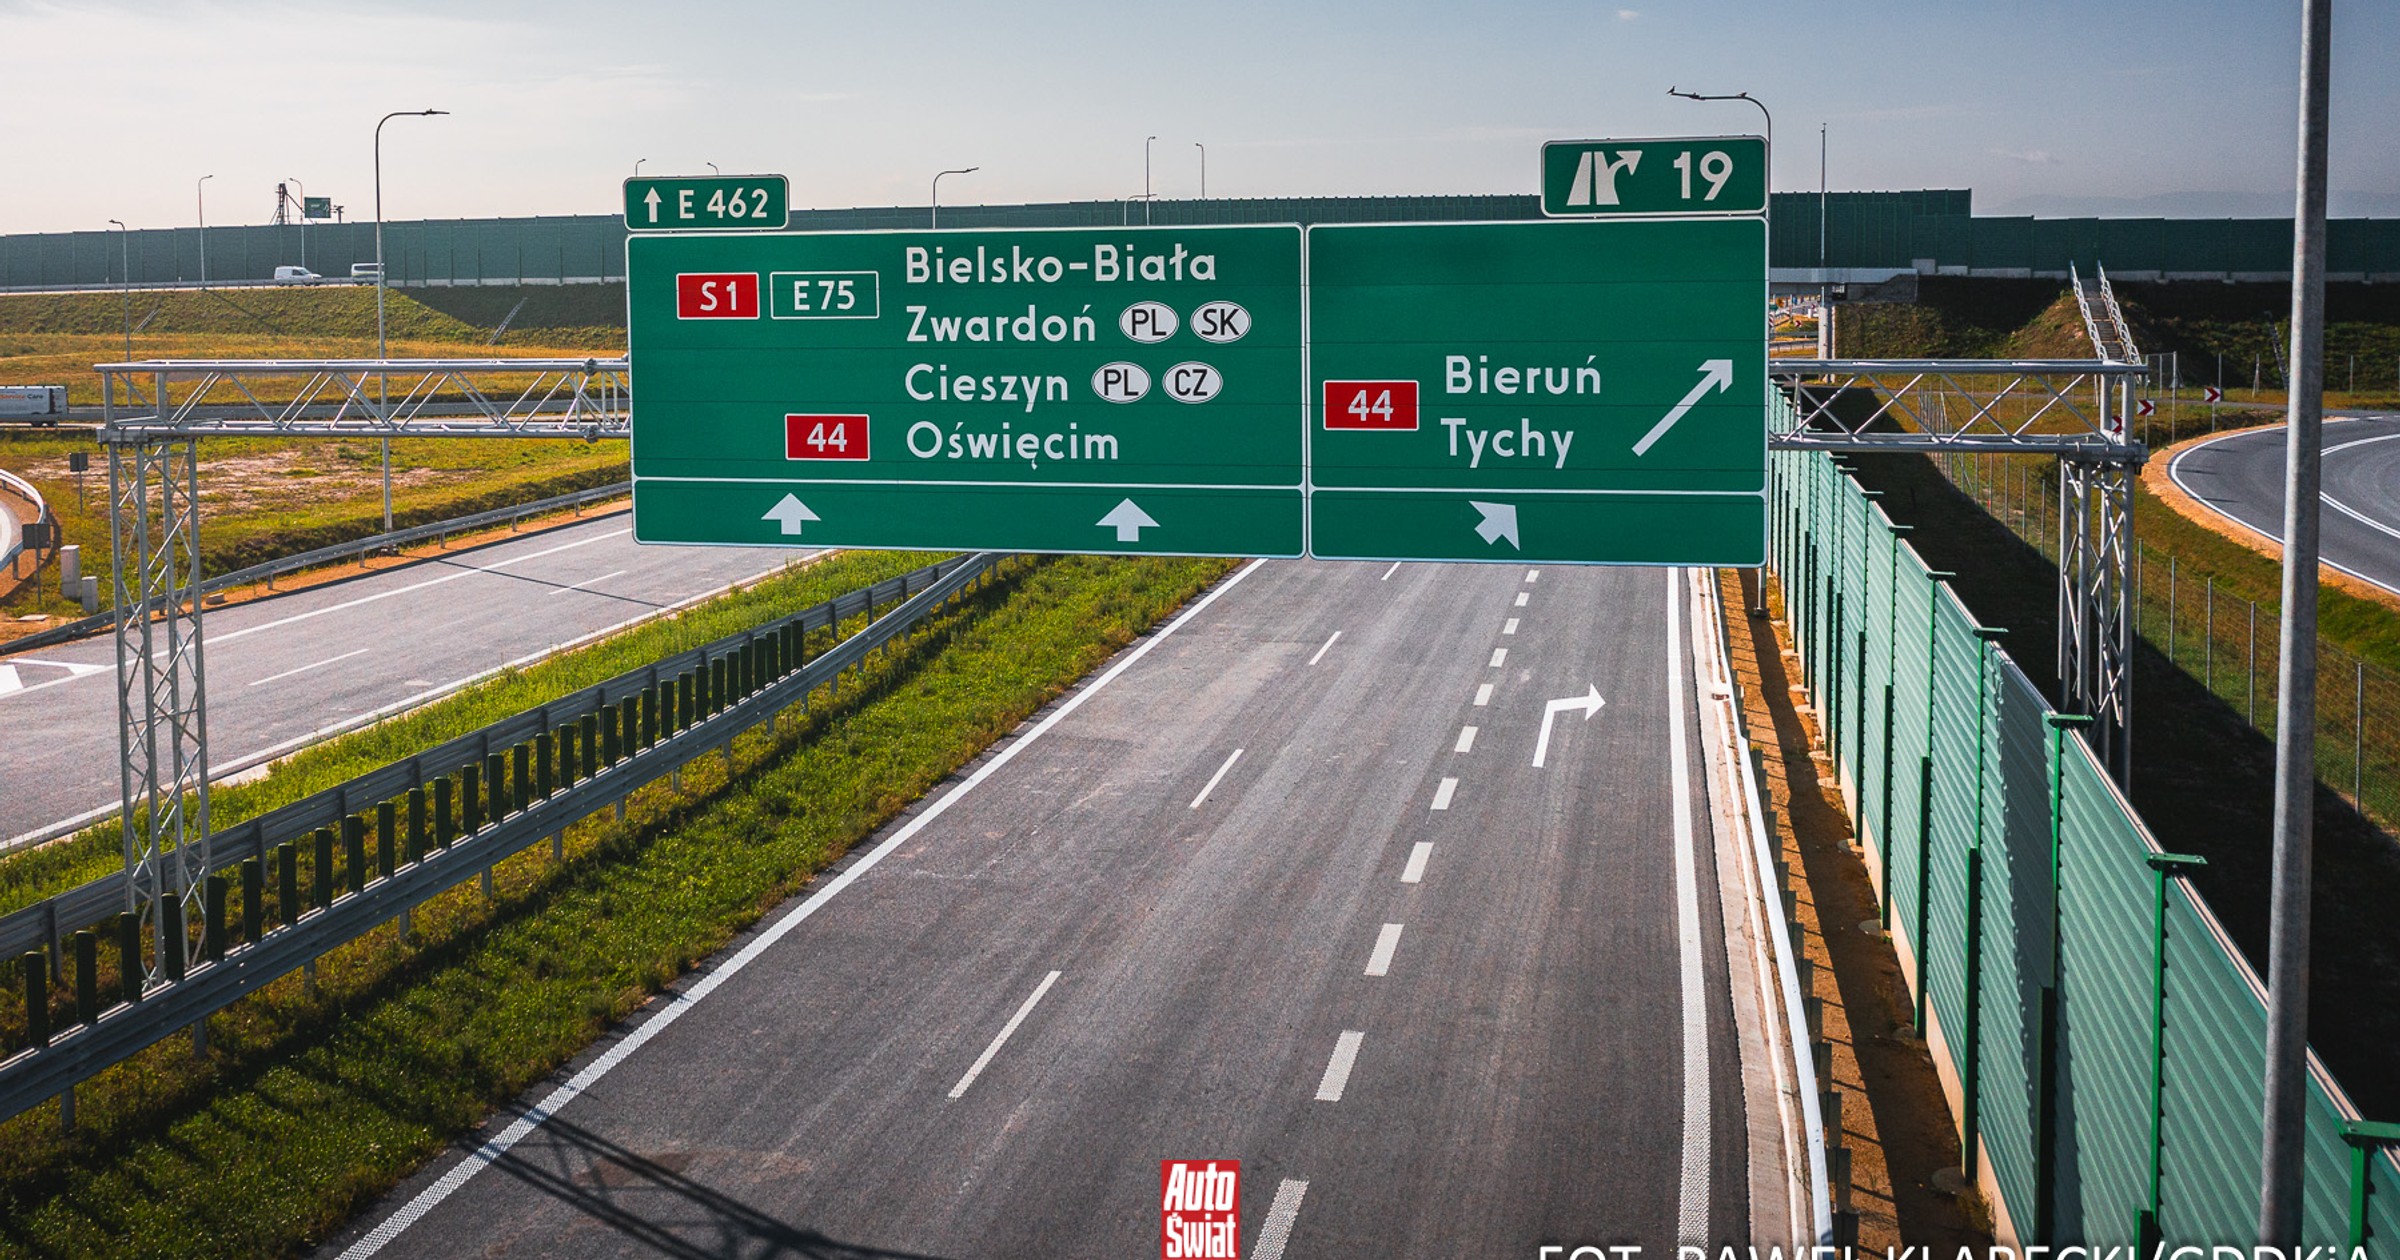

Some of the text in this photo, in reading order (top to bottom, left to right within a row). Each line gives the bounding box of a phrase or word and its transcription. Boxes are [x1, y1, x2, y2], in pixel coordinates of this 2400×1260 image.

[1673, 150, 1733, 201] 19
[679, 187, 769, 219] E 462
[906, 243, 1217, 284] Bielsko-Biała
[699, 281, 737, 311] S 1
[794, 280, 856, 311] E 75
[906, 304, 1241, 343] Zwardoń PL SK
[905, 363, 1209, 413] Cieszyn PL CZ
[1445, 355, 1602, 395] Bieruń
[1347, 389, 1394, 422] 44
[806, 422, 848, 453] 44
[906, 420, 1119, 471] Oświęcim
[1440, 417, 1575, 469] Tychy
